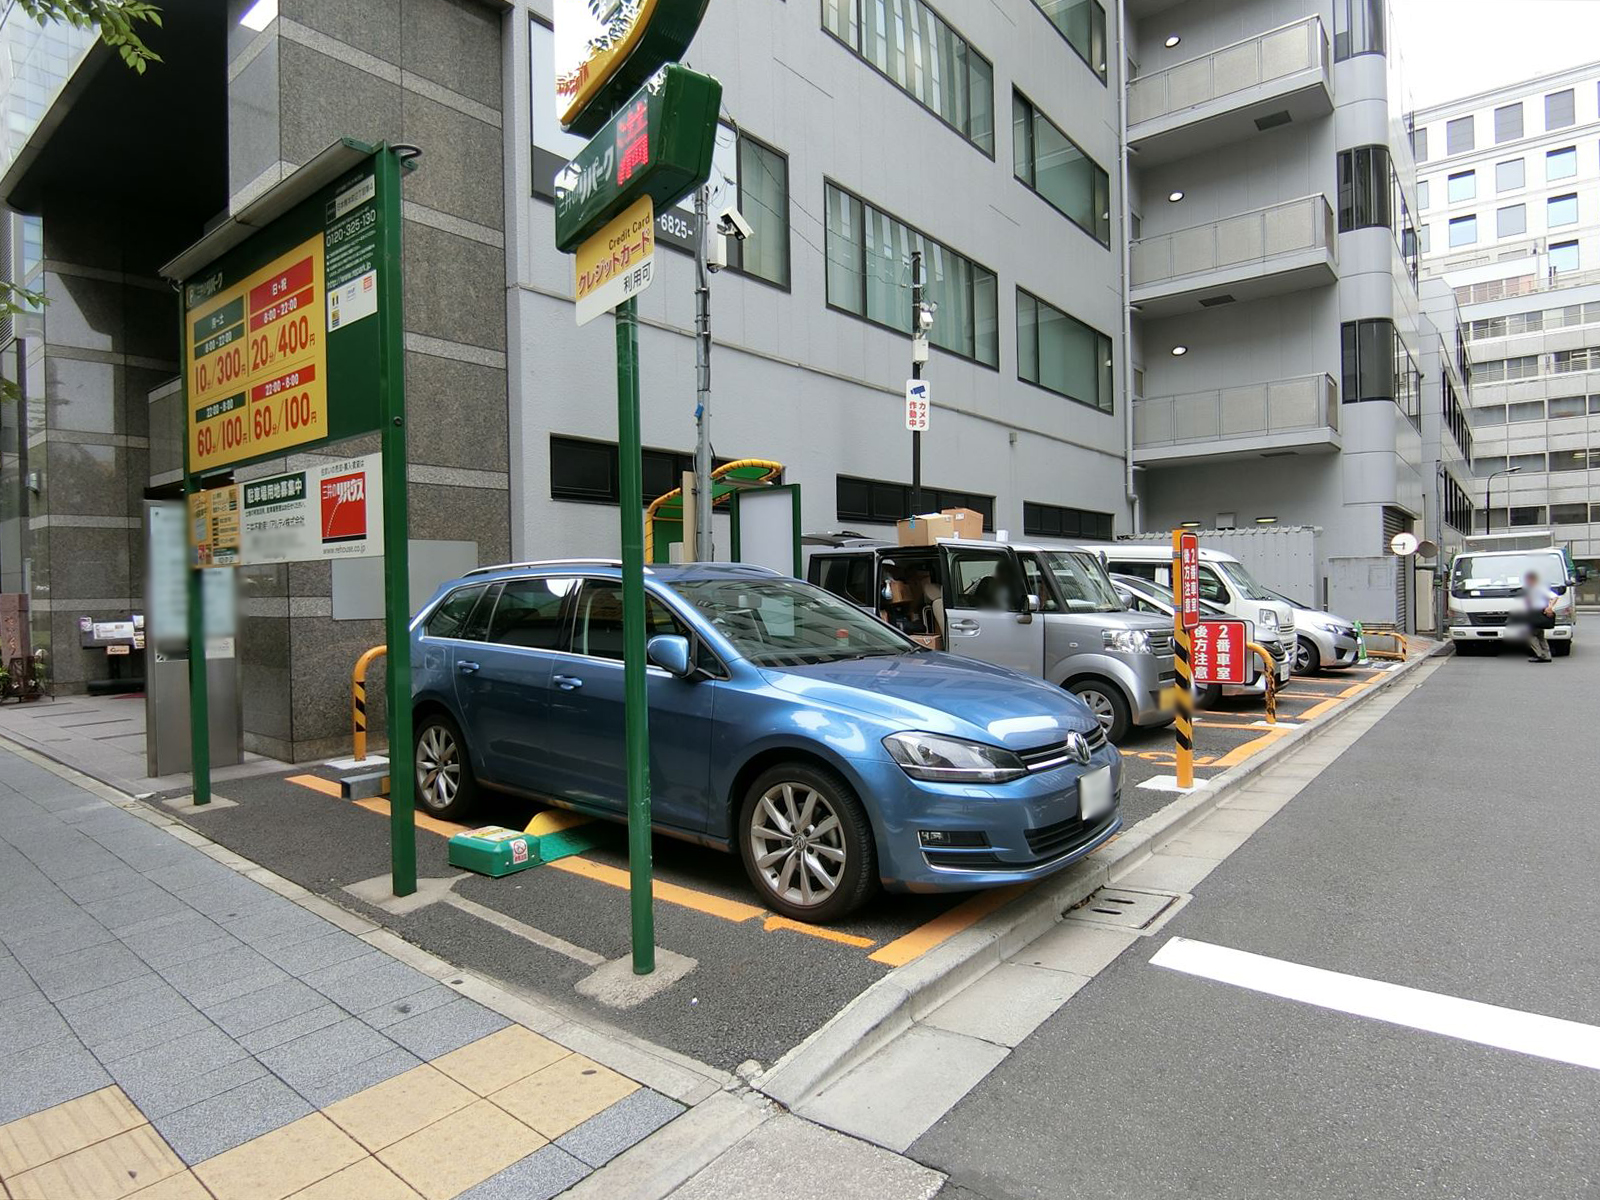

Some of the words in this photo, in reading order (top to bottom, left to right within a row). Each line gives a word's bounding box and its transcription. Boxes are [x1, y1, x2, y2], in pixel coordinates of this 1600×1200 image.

[608, 229, 630, 250] Credit
[632, 212, 651, 234] Card
[578, 228, 651, 296] クレジットカード
[623, 261, 651, 294] 利用可
[909, 401, 917, 428] 作動中
[918, 402, 926, 428] カメラ
[1183, 548, 1191, 614] 後方注意
[1194, 625, 1208, 680] 後方注意
[1216, 625, 1231, 680] 2番車室
